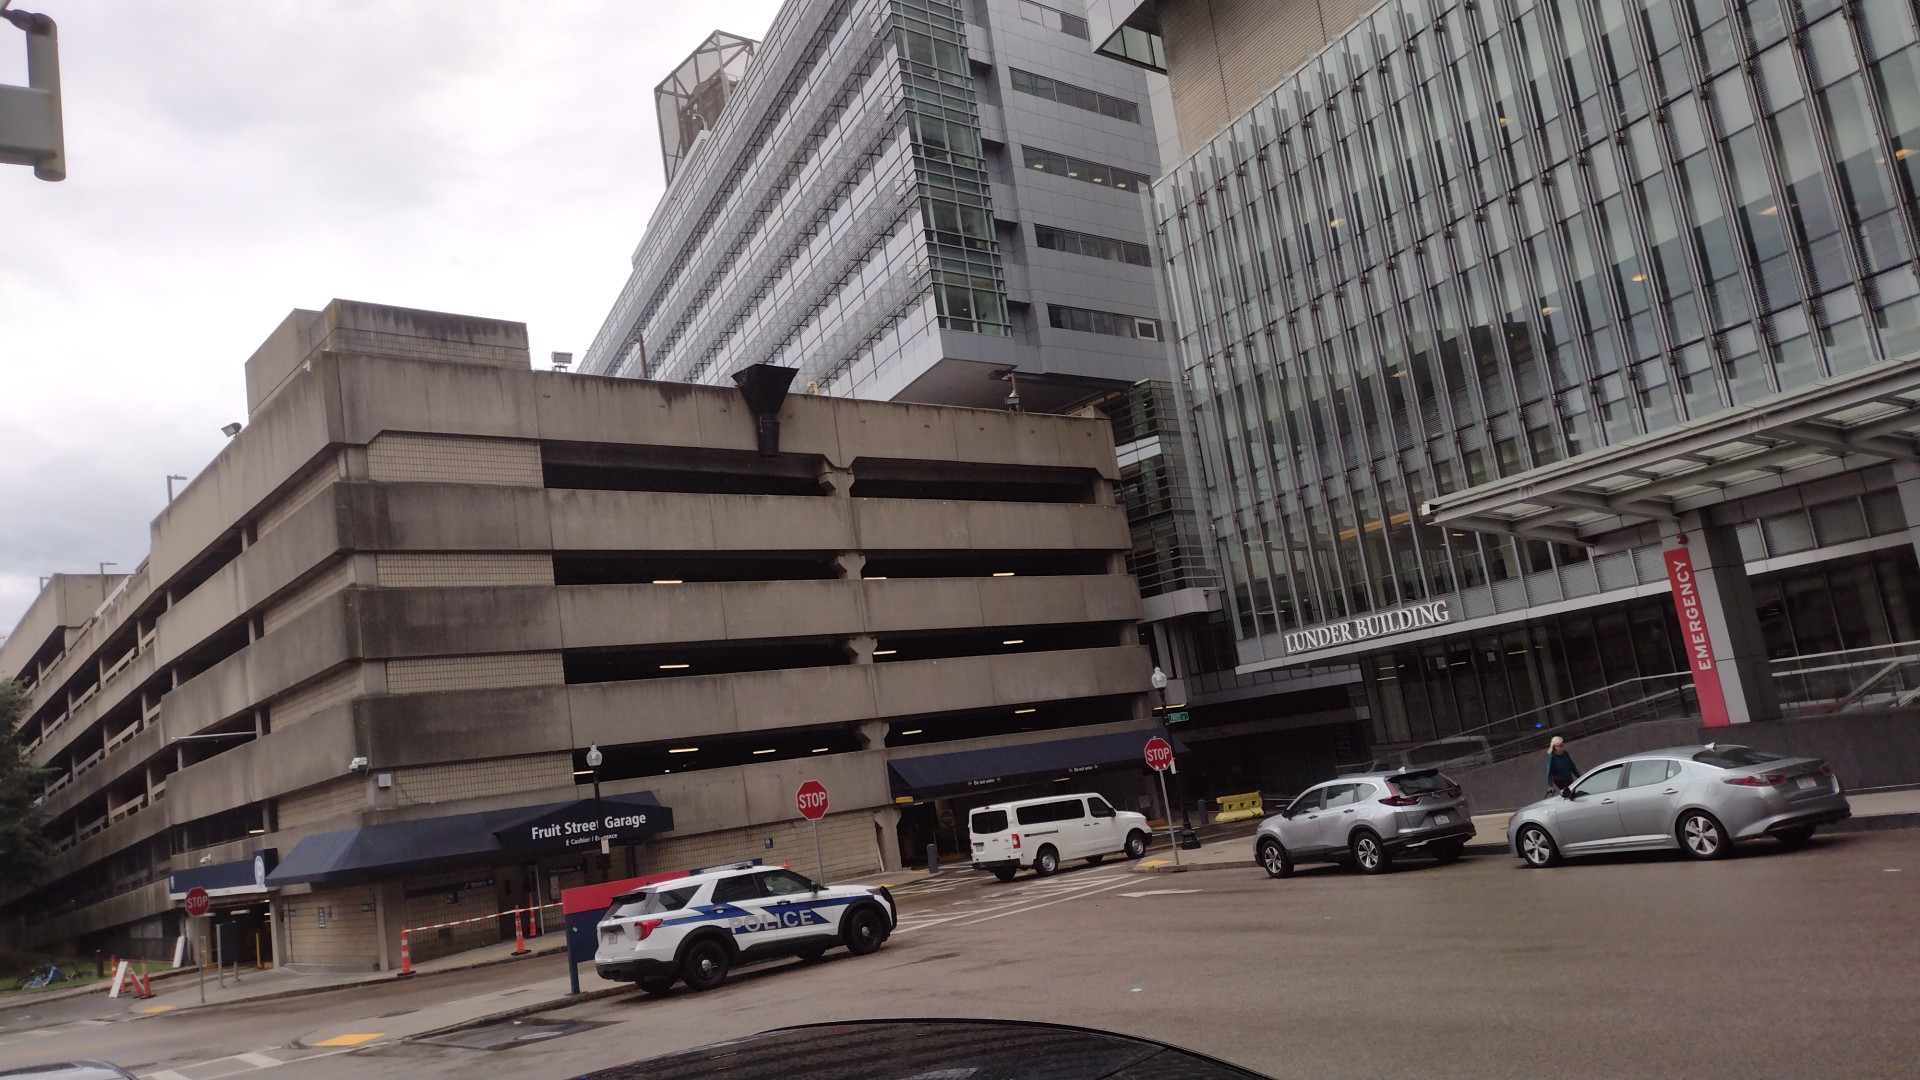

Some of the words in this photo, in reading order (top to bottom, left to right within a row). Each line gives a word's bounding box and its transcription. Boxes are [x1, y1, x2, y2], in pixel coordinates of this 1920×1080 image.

[1673, 560, 1711, 671] EMERGENCY
[1284, 622, 1353, 653] LUNDER
[1356, 600, 1449, 639] BUILDING
[1147, 747, 1170, 762] STOP
[799, 791, 827, 809] STOP
[531, 824, 561, 840] Fruit
[604, 814, 647, 829] Garage
[570, 837, 591, 845] Cashier
[187, 895, 208, 908] STOP
[728, 909, 813, 934] POLICE
